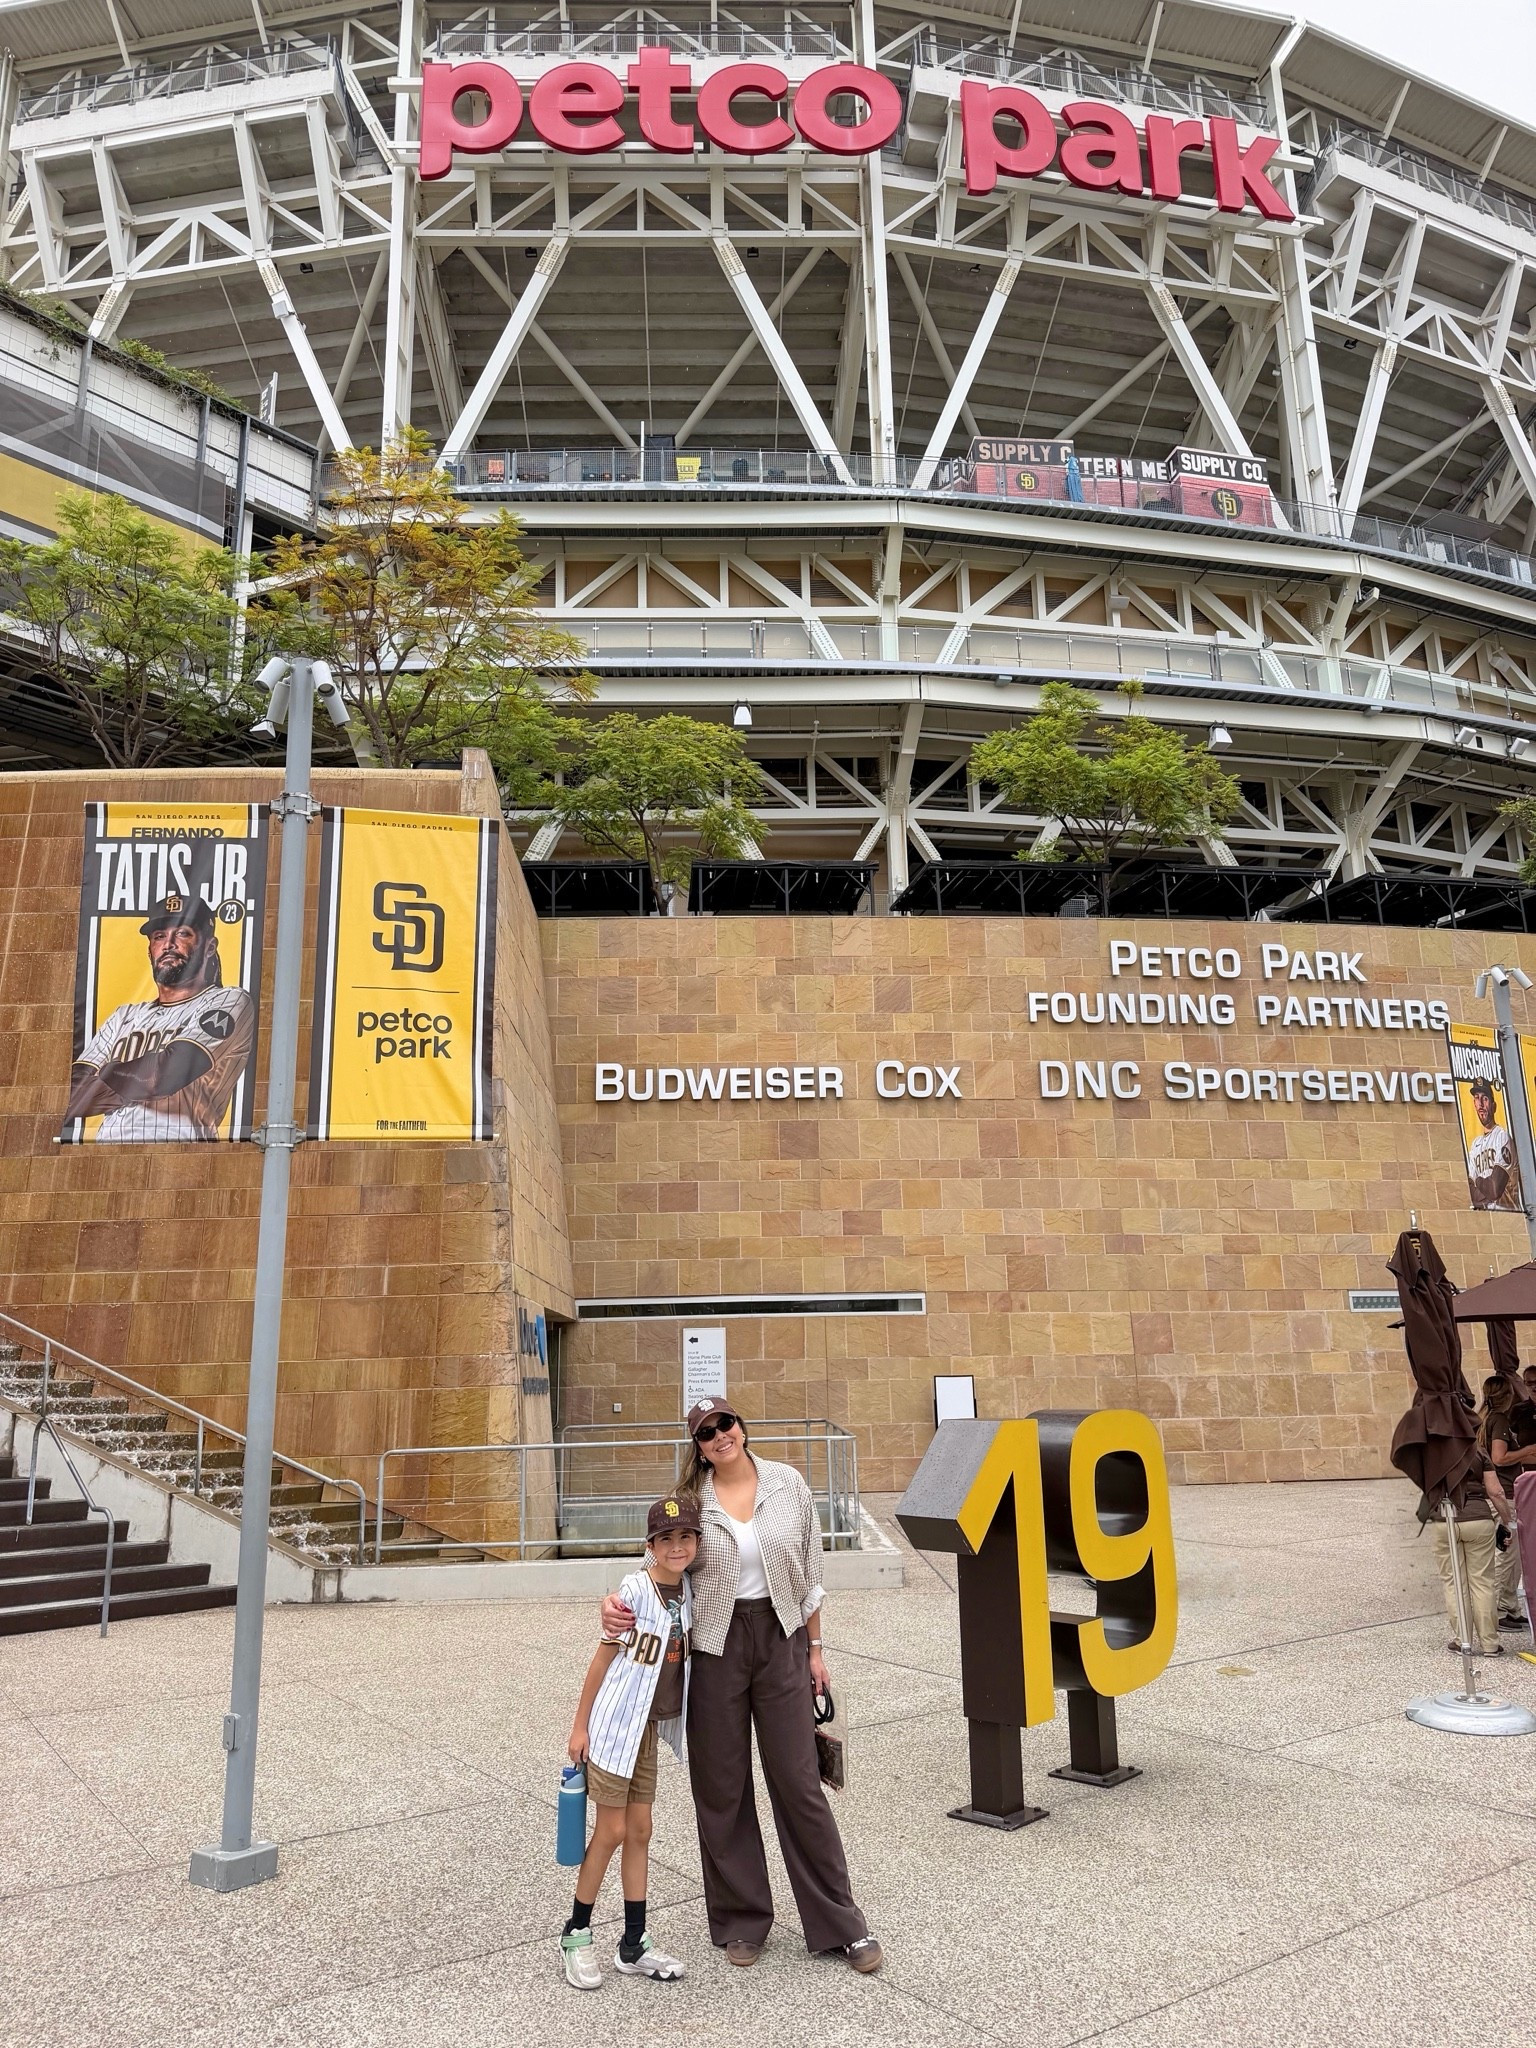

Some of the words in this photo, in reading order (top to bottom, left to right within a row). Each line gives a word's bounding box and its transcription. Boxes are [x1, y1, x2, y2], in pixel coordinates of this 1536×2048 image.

[419, 46, 902, 181] petco
[960, 79, 1297, 223] park
[978, 443, 1052, 463] SUPPLY
[1079, 457, 1134, 478] TERN
[1181, 453, 1236, 482] SUPPLY
[1242, 463, 1268, 482] CO.
[131, 827, 225, 838] FERNANDO
[95, 843, 192, 911] TATIS
[200, 843, 255, 911] JR.
[225, 904, 237, 922] 23
[357, 1008, 453, 1037] petco
[1028, 992, 1236, 1025] FOUNDING
[1258, 995, 1451, 1030] PARTNERS
[375, 1036, 452, 1064] park
[1450, 1045, 1504, 1083] MUSGROVE
[1039, 1060, 1142, 1099] DNC
[376, 1120, 388, 1130] FOR
[398, 1120, 428, 1130] FAITHFUL
[956, 1409, 1178, 1728] 19
